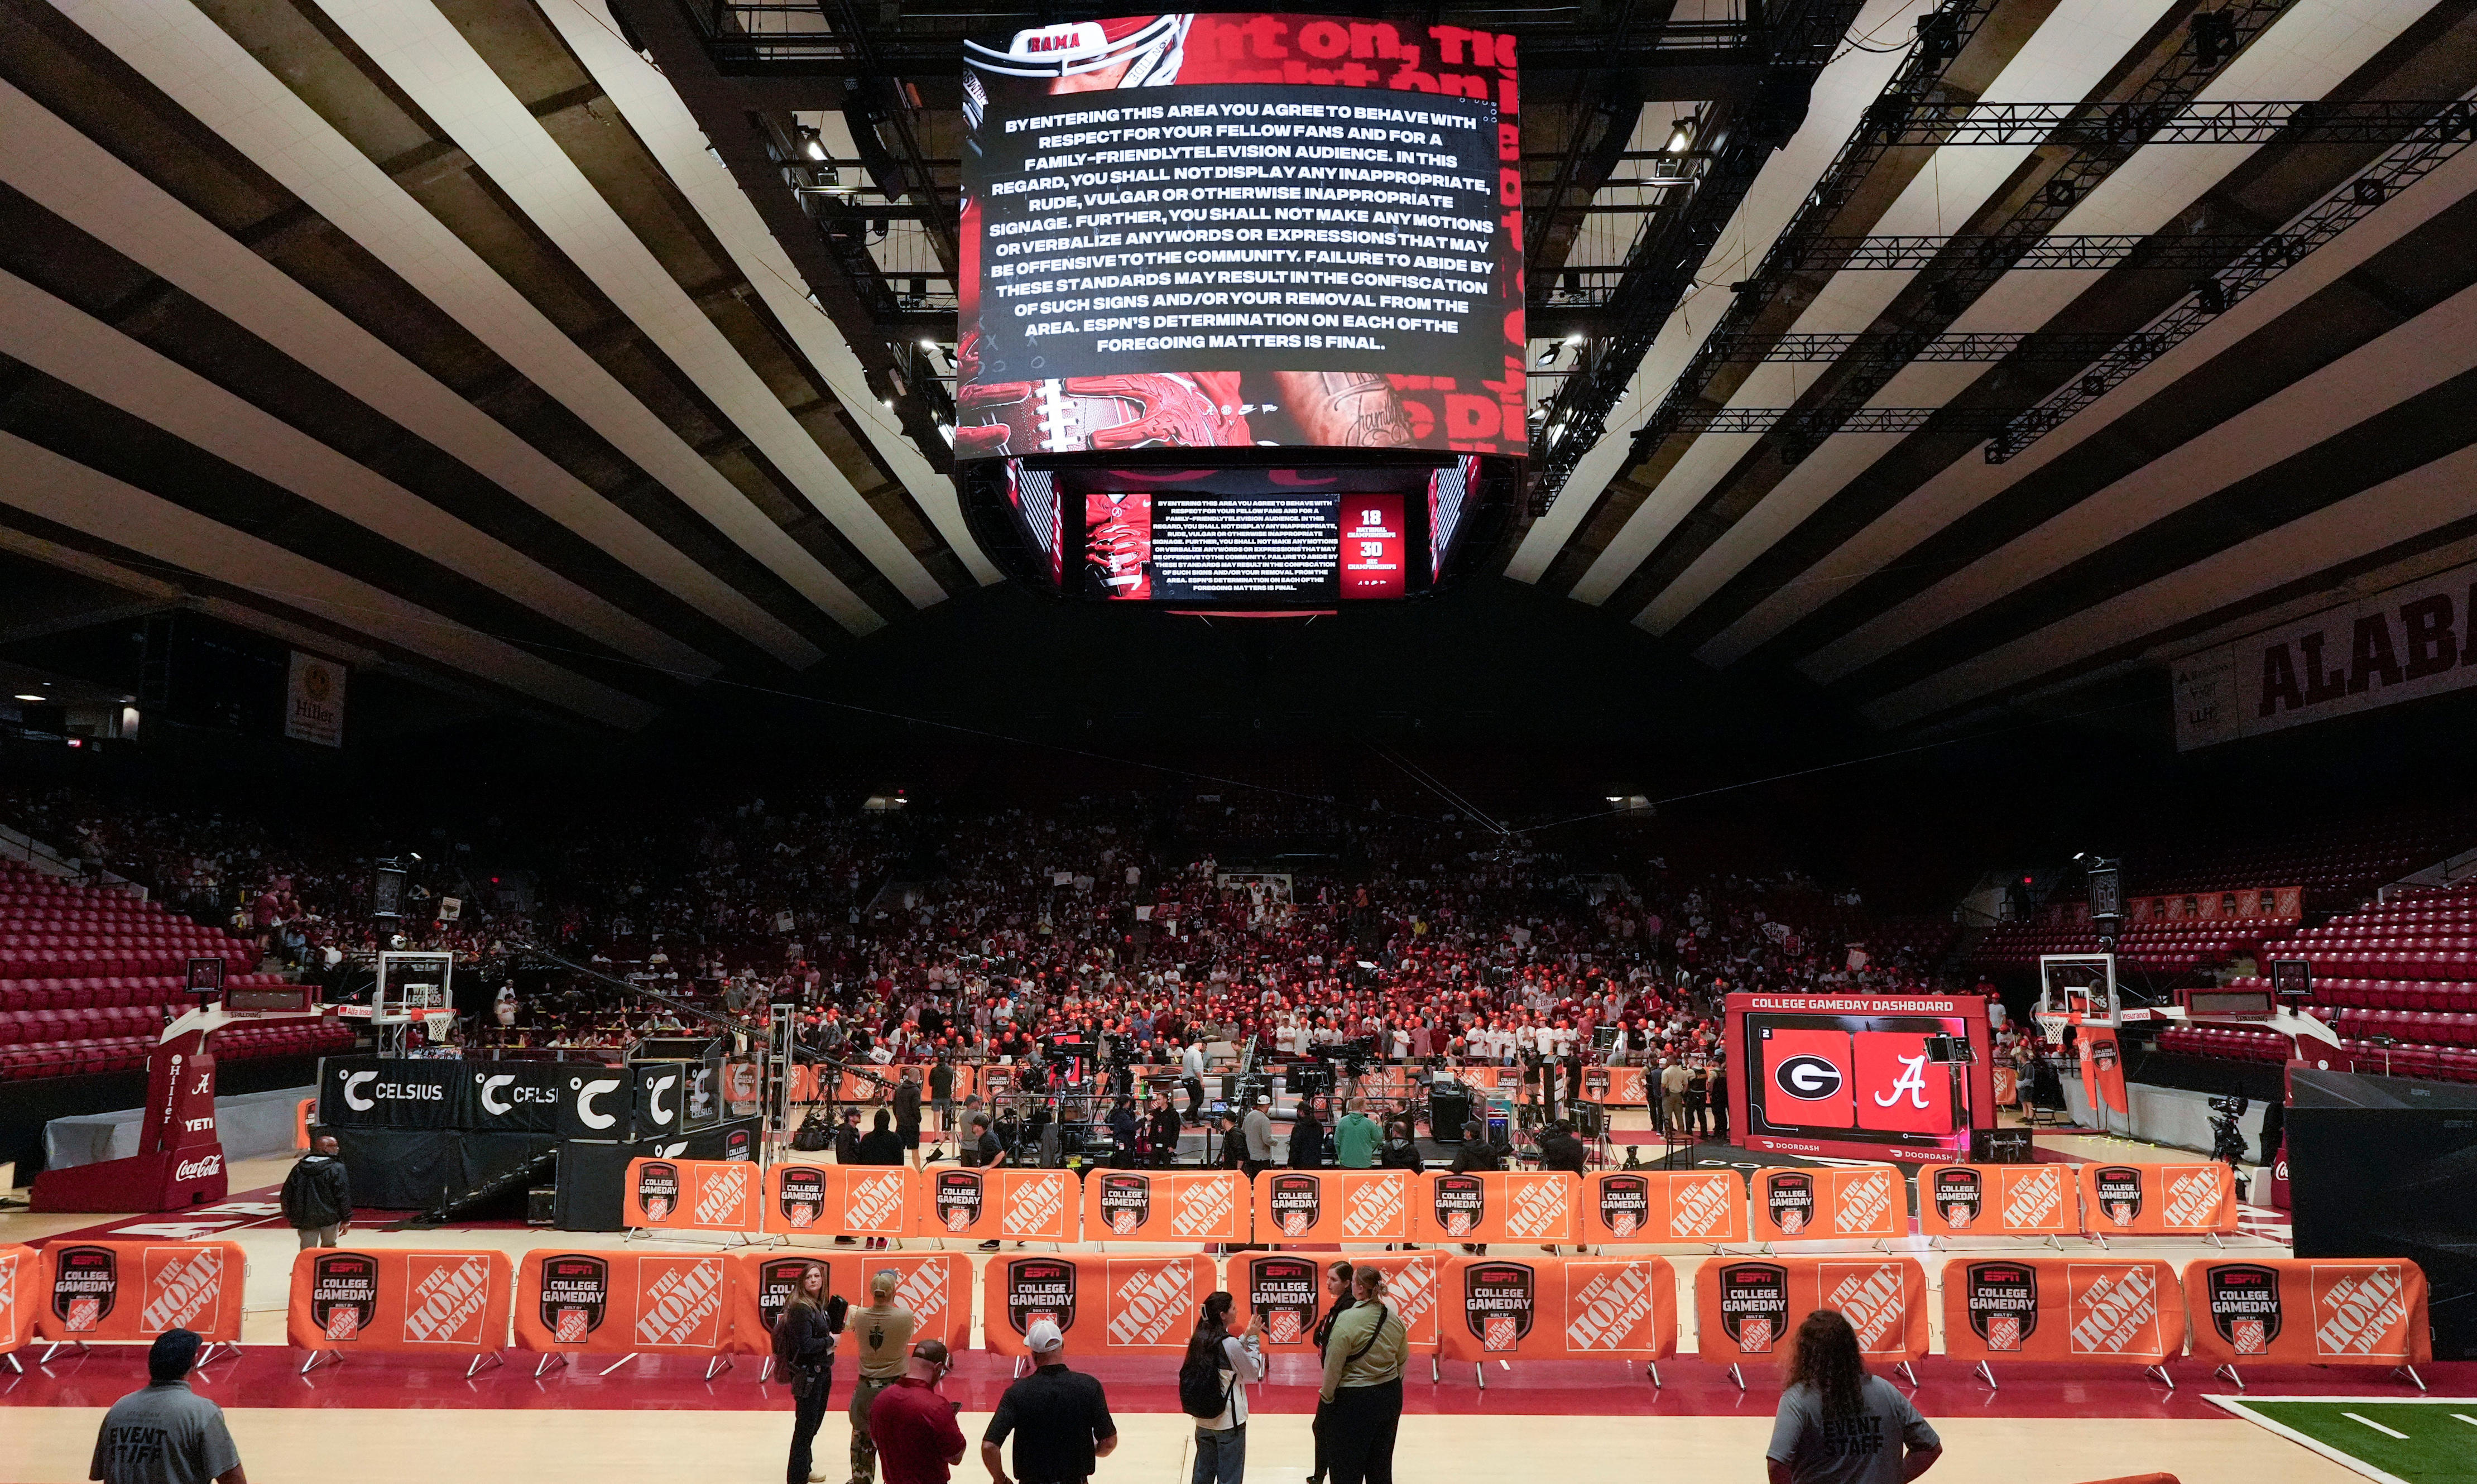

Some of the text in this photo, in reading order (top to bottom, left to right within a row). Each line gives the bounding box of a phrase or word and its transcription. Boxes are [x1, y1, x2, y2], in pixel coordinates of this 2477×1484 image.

[1028, 32, 1081, 52] BAMA
[1005, 103, 1476, 133] BY ENTERING THIS AREA YOU AGREE TO BEHAVE WITH
[1039, 124, 1443, 149] RESPECT FOR YOUR FELLOW FANS AND FOR A
[1294, 146, 1393, 162] AUDIENCE.
[1396, 151, 1415, 164] IN
[1416, 152, 1458, 168] THIS
[992, 166, 1490, 195] REGARD, YOU SHALL NOT DISPLAY ANY INAPPROPRIATE,
[1029, 186, 1453, 213] RUDE, VULGAR OR OTHERWISE INAPPROPRIATE
[989, 208, 1494, 237] SIGNAGE. FURTHER, YOU SHALL NOT MAKE ANY MOTIONS
[996, 243, 1020, 257] OR
[1021, 233, 1122, 253] VERBALIZE
[1236, 228, 1263, 241] OR
[1266, 228, 1396, 246] EXPRESSIONS
[1397, 233, 1448, 249] THAT
[1450, 238, 1489, 253] MAY
[991, 249, 1494, 278] BE OFFENSIVE TO THE COMMUNITY. FAILURE TO ABIDE BY
[995, 270, 1488, 297] THESE STANDARDS MAY RESULT IN THE CONFISCATION
[1014, 291, 1469, 317] OF SUCH SIGNS AND/OR YOUR REMOVAL FROM THE
[1025, 320, 1079, 337] AREA.
[1083, 316, 1150, 332] ESPN'S
[1153, 313, 1309, 328] DETERMINATION
[1312, 314, 1339, 327] ON
[1343, 315, 1394, 329] EACH
[1097, 334, 1385, 352] FOREGOING MATTERS IS FINAL.
[1361, 510, 1381, 525] 18
[1360, 541, 1382, 557] 30
[296, 699, 334, 723] Hiller
[1007, 950, 1015, 958] 18
[347, 1007, 358, 1015] Alfa
[1751, 998, 1953, 1012] COLLEGE GAMEDAY DASHBOARD
[2121, 1011, 2149, 1020] Insurance
[1761, 1029, 1770, 1039] 2
[163, 1065, 181, 1124] Hiller
[376, 1083, 443, 1100] CELSIUS
[185, 1117, 214, 1132] YETI
[728, 1145, 747, 1156] COLLEGE
[1776, 1142, 1820, 1151] DOORDASH
[1905, 1151, 1953, 1161] DOORDASH
[1271, 1199, 1318, 1208] GAMEDAY
[1481, 1272, 1518, 1283] ESPN
[1474, 1288, 1524, 1298] COLLEGE
[1575, 1272, 1611, 1306] THE
[1466, 1298, 1533, 1311] GAMEDAY
[1567, 1262, 1651, 1351] HOME
[1602, 1294, 1652, 1350] DEPOT
[1823, 1416, 1882, 1437] EVENT
